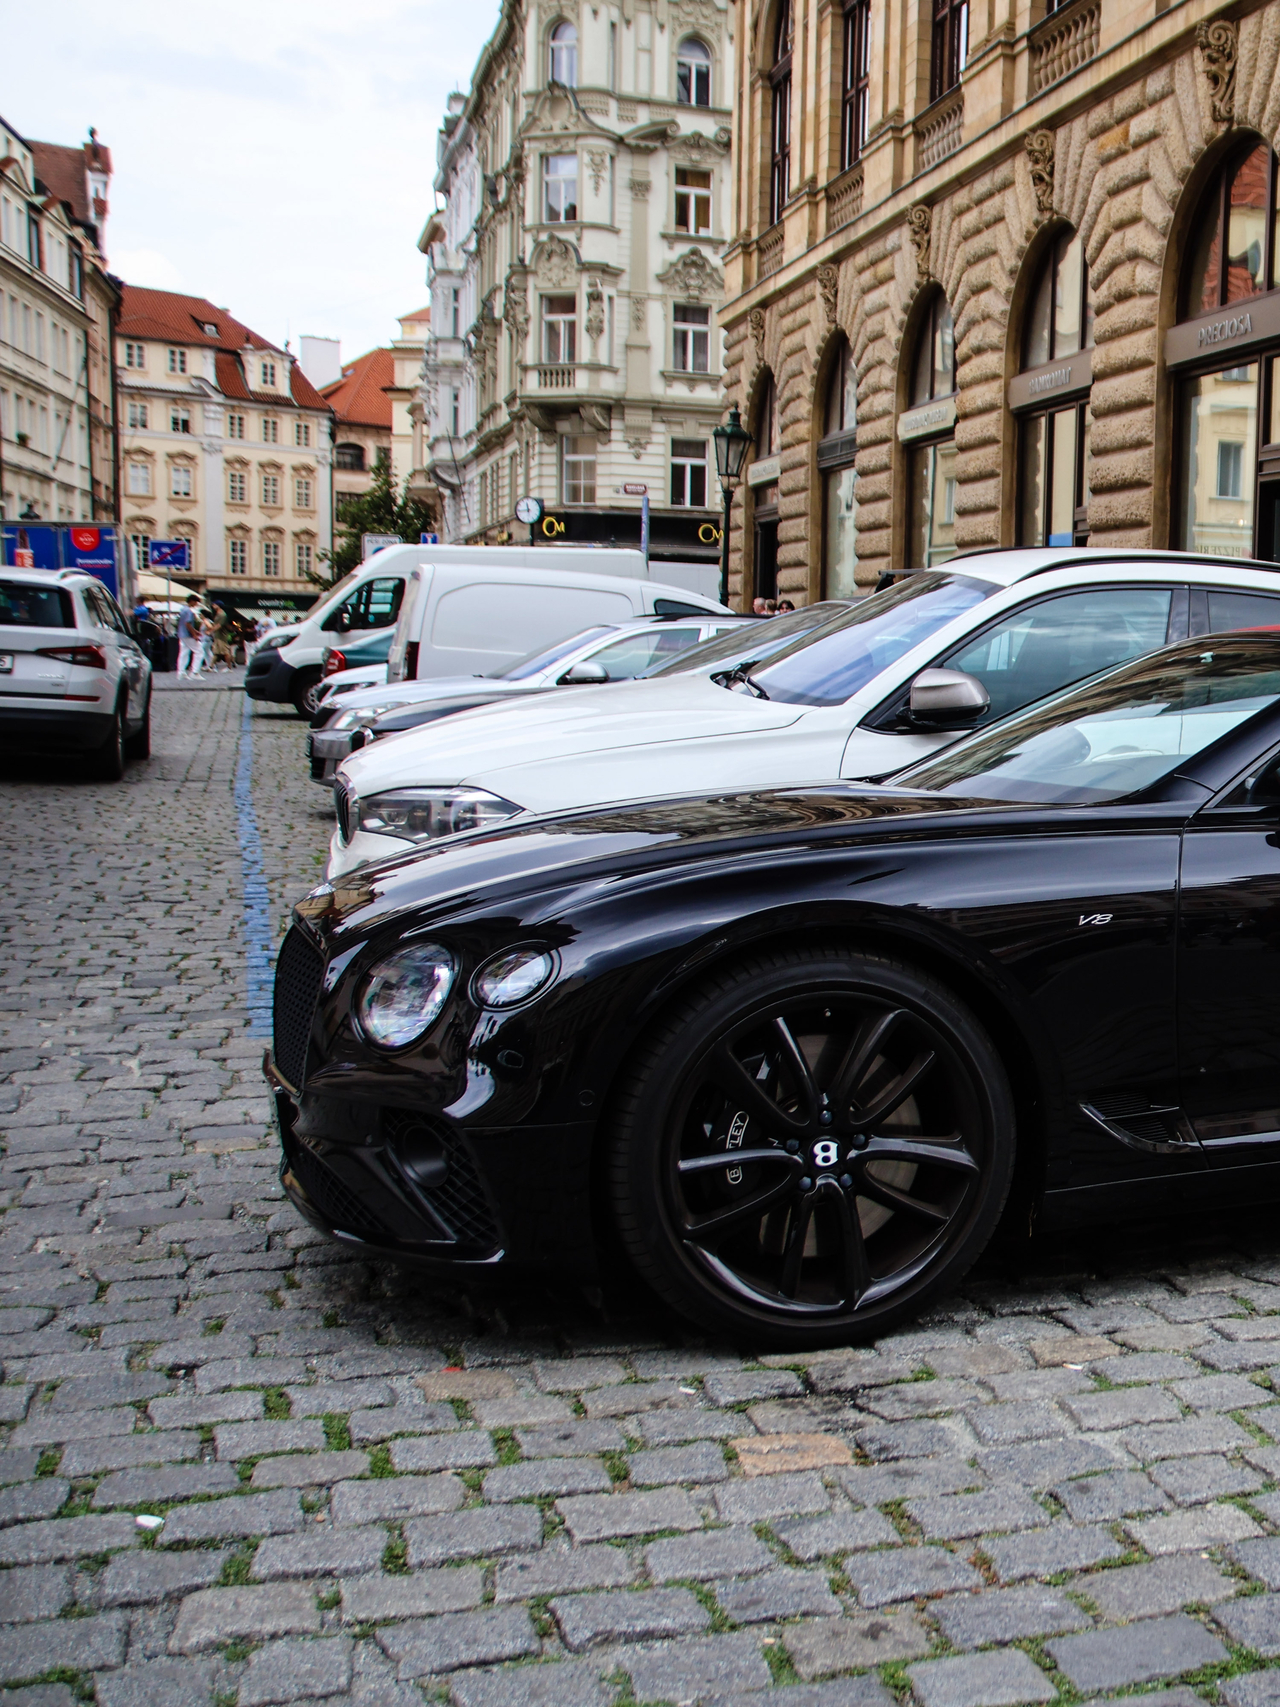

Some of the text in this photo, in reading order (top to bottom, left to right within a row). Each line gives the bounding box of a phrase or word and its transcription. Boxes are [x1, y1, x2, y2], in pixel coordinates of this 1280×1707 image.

[1197, 313, 1252, 347] PRECIOSA
[1078, 913, 1114, 926] V8
[729, 1117, 746, 1178] BTLEY
